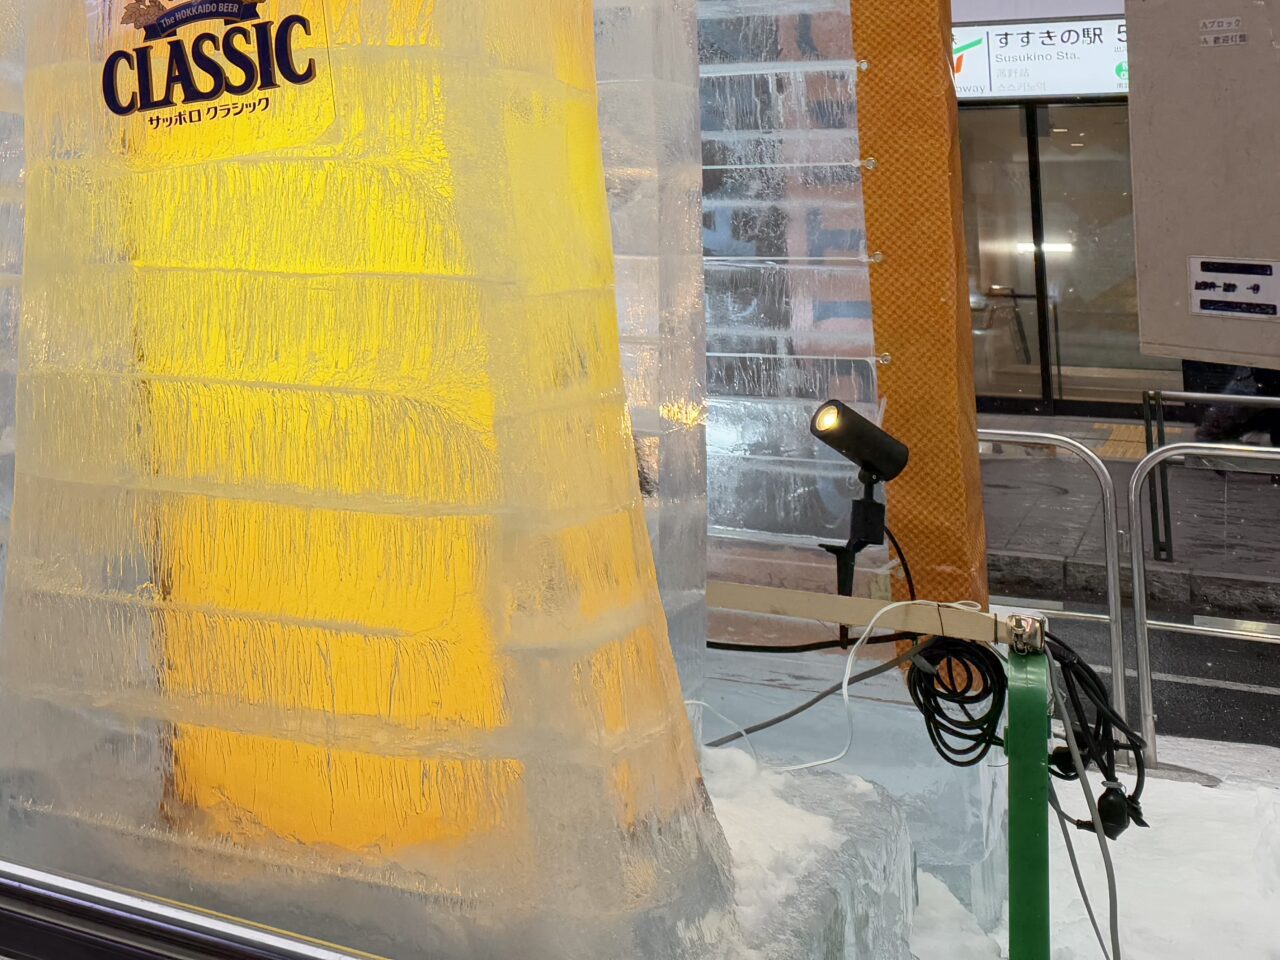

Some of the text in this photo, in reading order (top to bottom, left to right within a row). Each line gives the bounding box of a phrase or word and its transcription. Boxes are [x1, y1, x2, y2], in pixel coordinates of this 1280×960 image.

[160, 2, 240, 29] The HOKKAIDO BEER
[995, 27, 1104, 49] すすきの駅
[102, 14, 318, 117] CLASSIC
[995, 50, 1081, 64] Susukino Sta.
[148, 97, 270, 130] サッポロ クラシック
